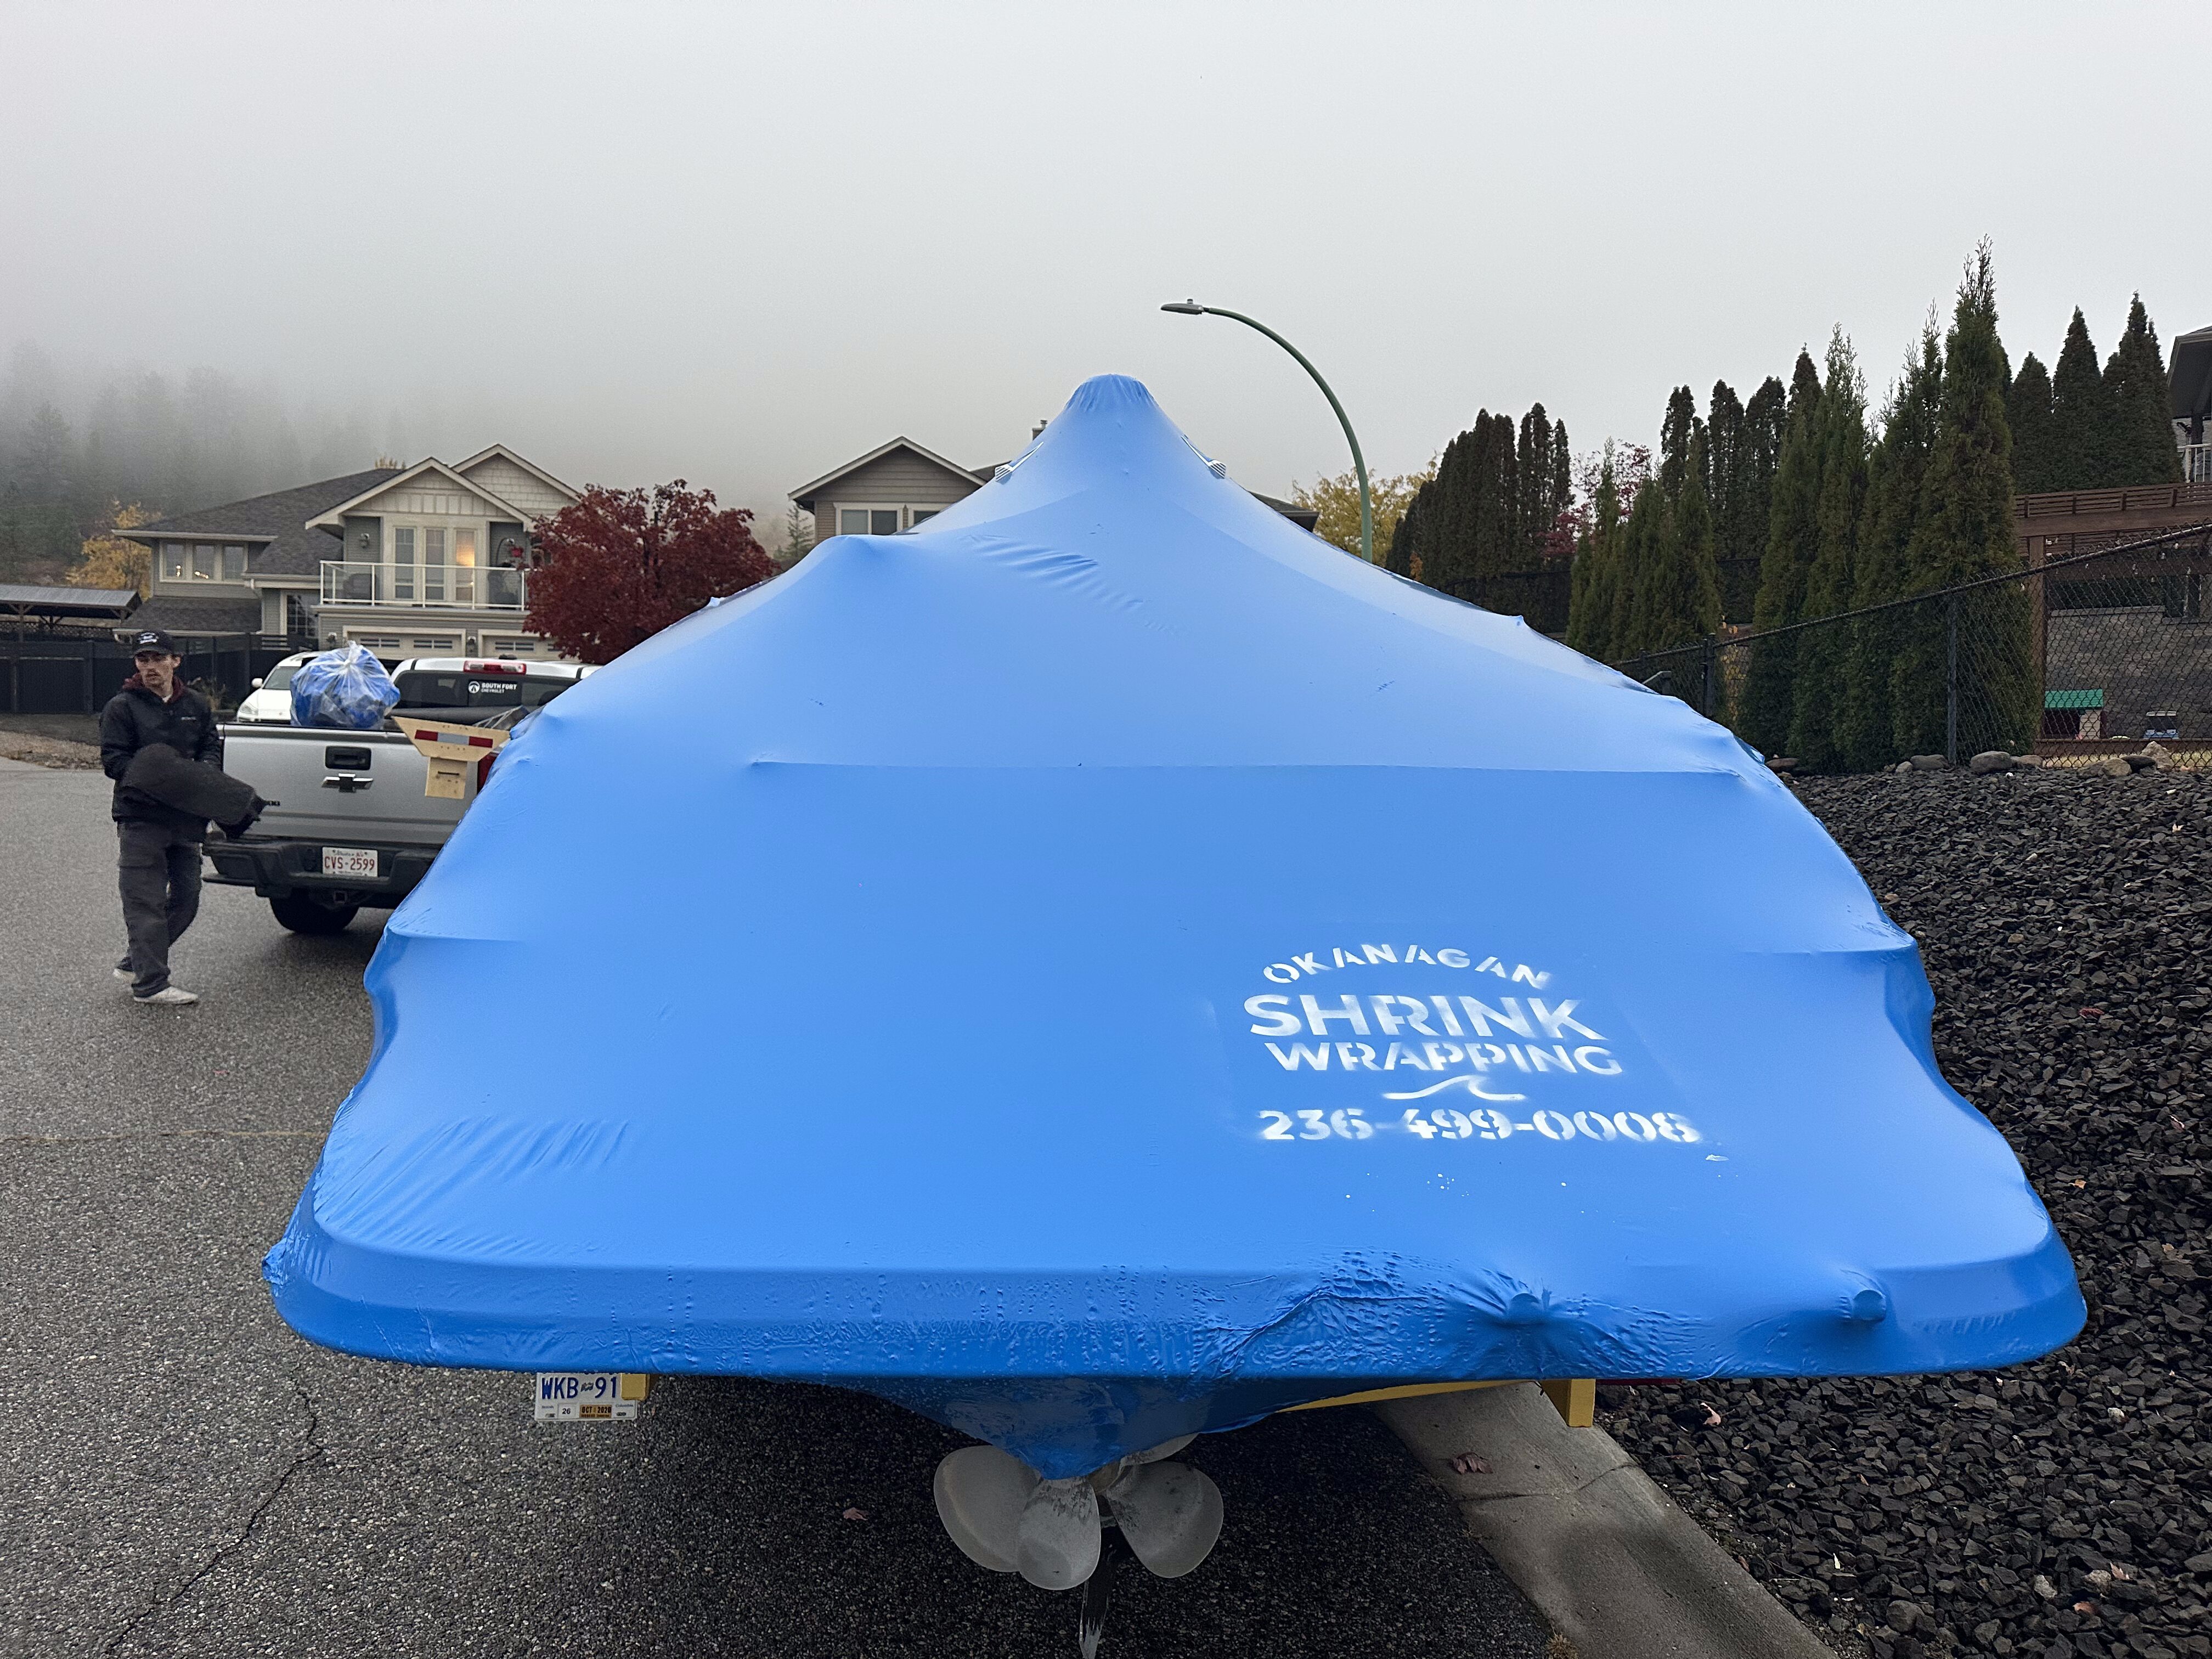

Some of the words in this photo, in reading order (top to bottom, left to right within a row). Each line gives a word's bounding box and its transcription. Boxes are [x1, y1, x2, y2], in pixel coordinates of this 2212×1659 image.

[324, 856, 375, 871] CVS-2599
[1263, 944, 1550, 988] OKANAGAN
[1243, 994, 1609, 1040] SHRINK
[1264, 1042, 1623, 1075] WRAPPING
[1259, 1108, 1702, 1143] 236-499-0008
[541, 1377, 579, 1399] WKB
[595, 1376, 617, 1398] 91
